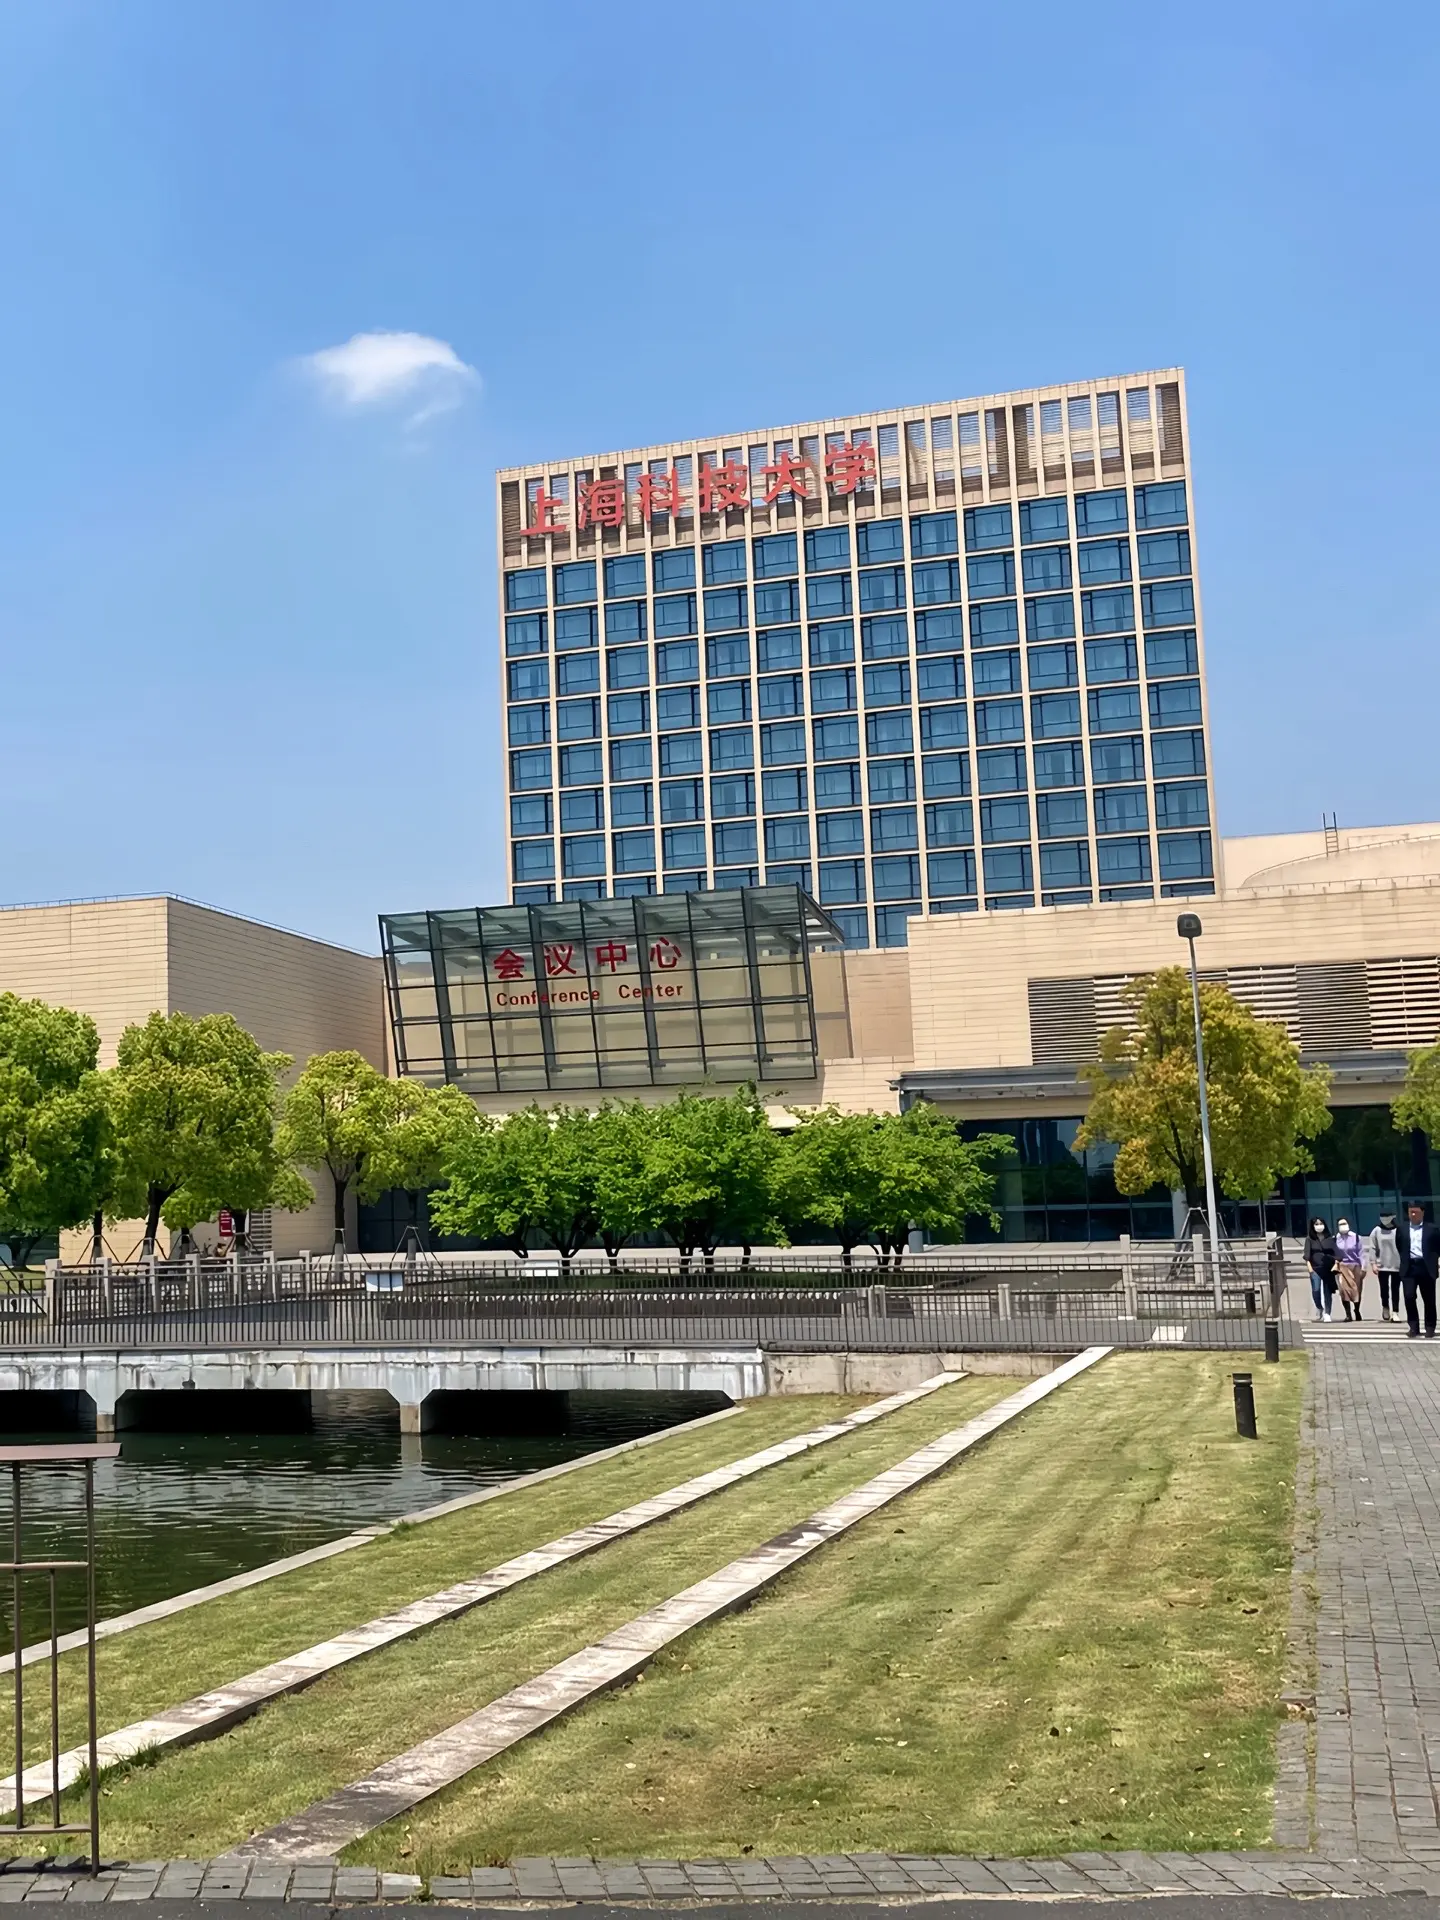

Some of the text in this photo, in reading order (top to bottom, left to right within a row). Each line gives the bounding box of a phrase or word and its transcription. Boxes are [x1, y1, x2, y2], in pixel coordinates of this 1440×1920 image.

[520, 440, 877, 536] 上海科技大学
[493, 936, 682, 979] 会议中心
[496, 984, 683, 1006] Conference Center
